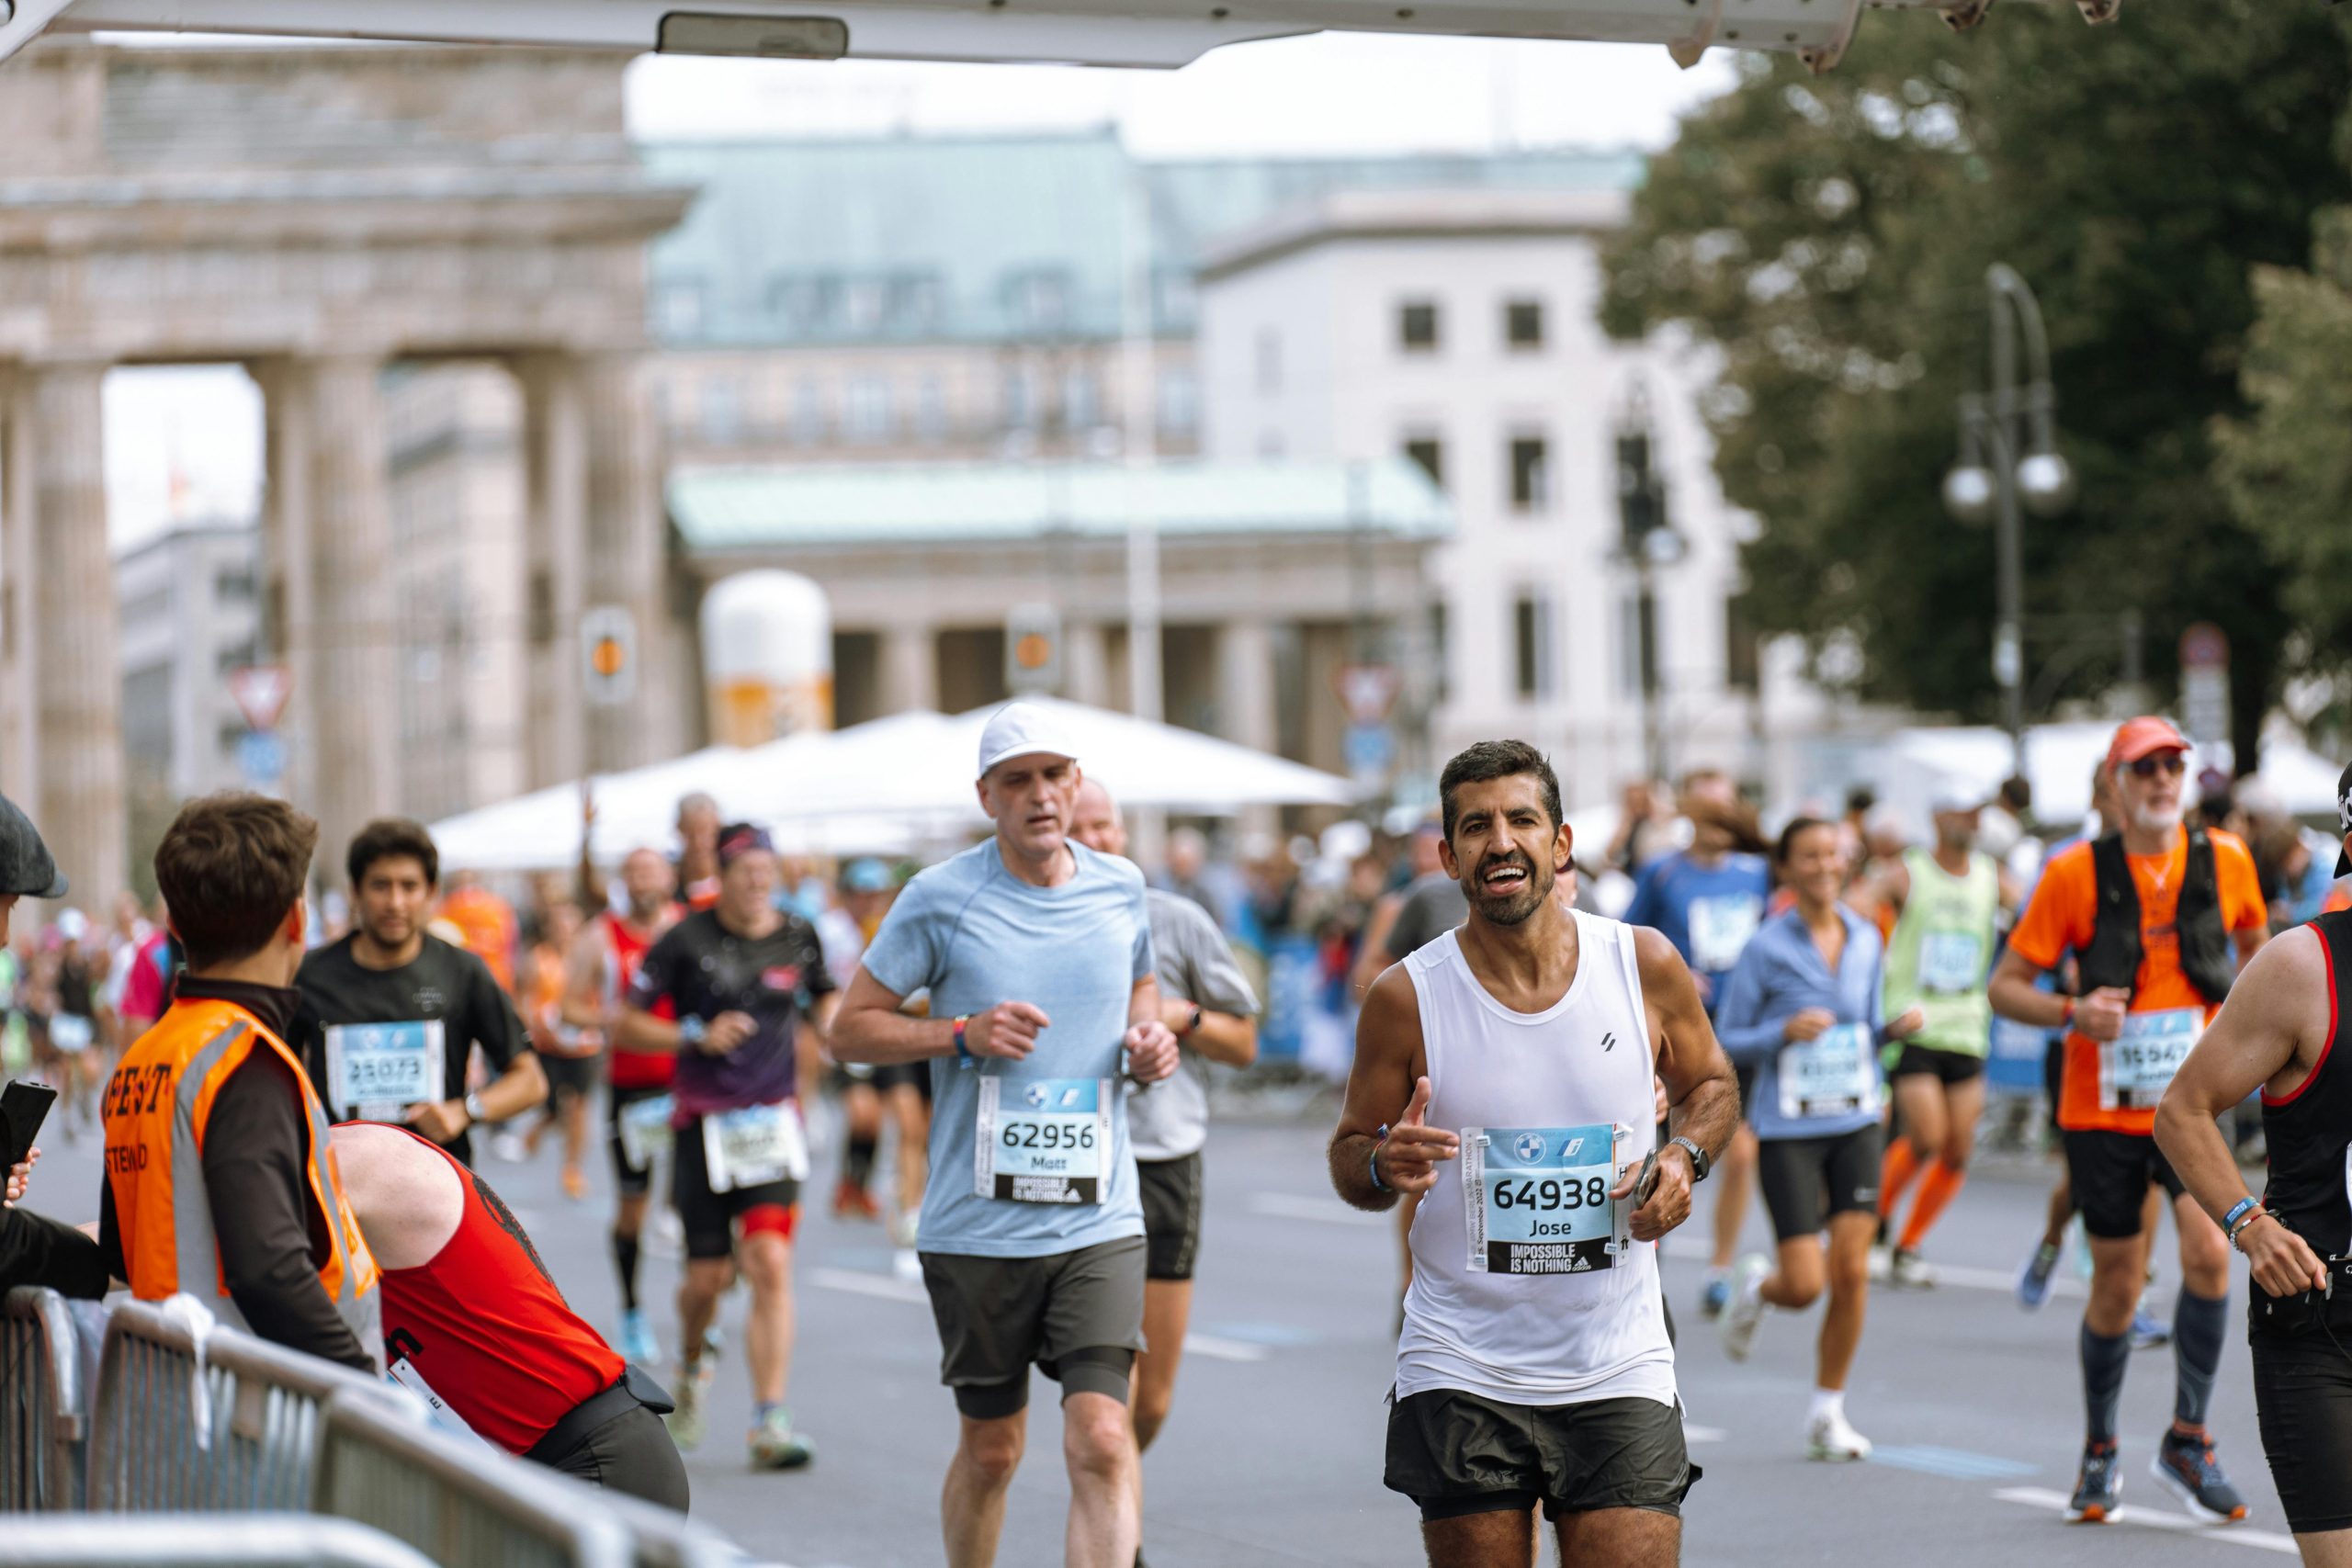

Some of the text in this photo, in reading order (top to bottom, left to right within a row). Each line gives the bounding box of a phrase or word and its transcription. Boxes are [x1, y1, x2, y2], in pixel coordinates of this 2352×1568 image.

[1003, 1122, 1093, 1148] 62956
[1030, 1156, 1068, 1169] Matt
[1494, 1177, 1606, 1211] 64938
[1529, 1220, 1572, 1237] Jose
[1510, 1244, 1576, 1258] IMPOSSIBLE
[1510, 1258, 1572, 1273] IS NOTHING
